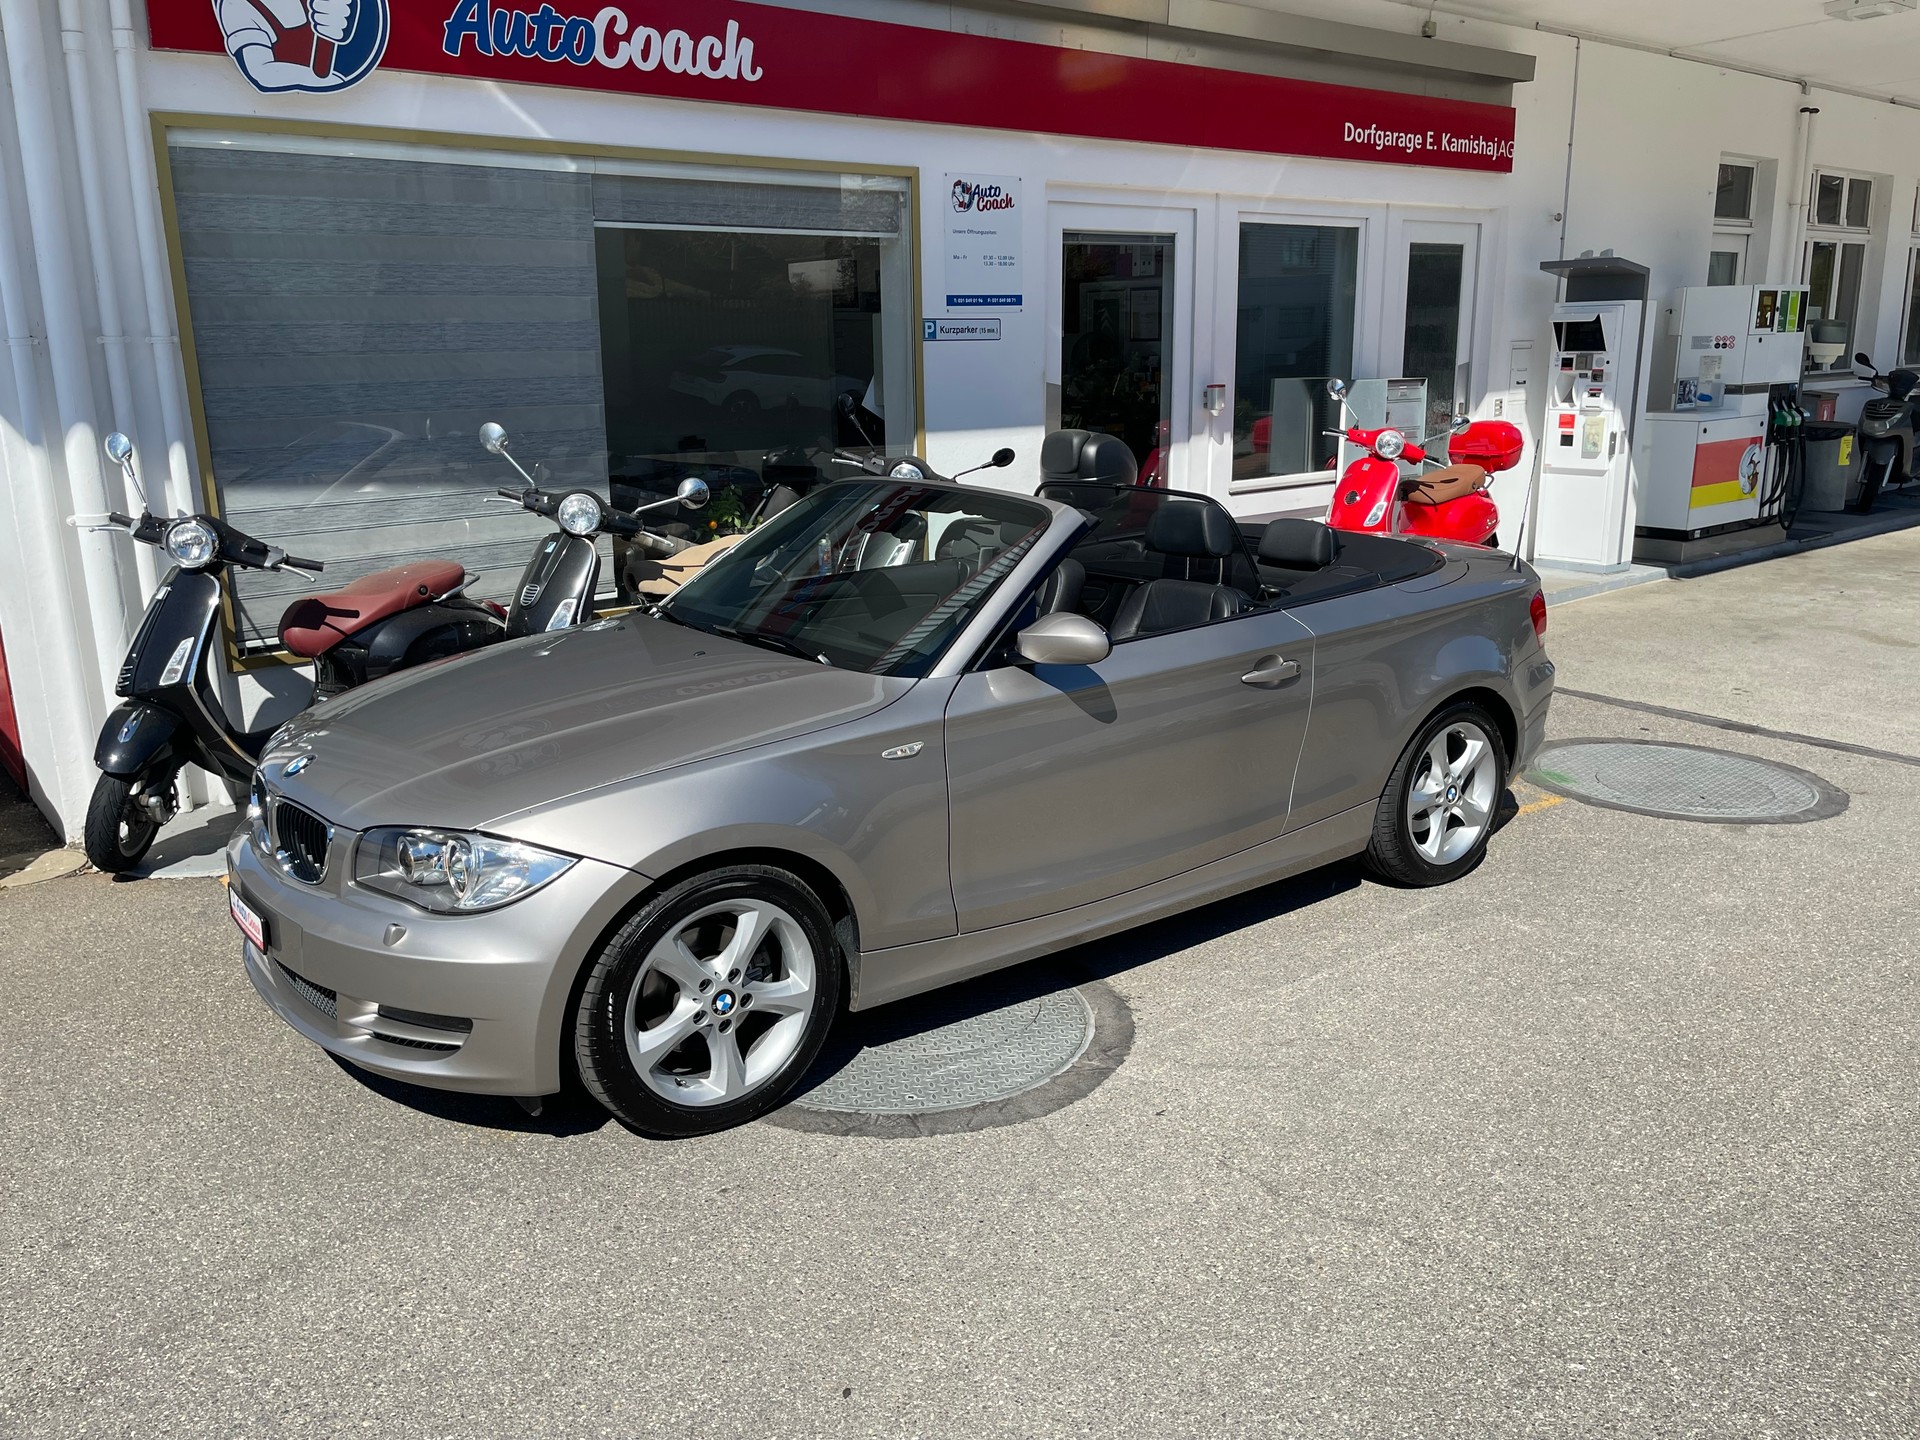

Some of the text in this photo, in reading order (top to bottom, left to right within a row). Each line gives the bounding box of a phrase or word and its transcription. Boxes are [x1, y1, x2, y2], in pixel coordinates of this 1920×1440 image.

[1344, 122, 1422, 153] Dorfgarage
[1426, 131, 1437, 151] E.
[1441, 133, 1498, 161] Kamishaj
[972, 184, 1001, 198] Auto
[976, 193, 1015, 212] Coach
[1765, 311, 1771, 326] 1
[924, 322, 935, 338] P
[939, 326, 978, 335] Kurzparker
